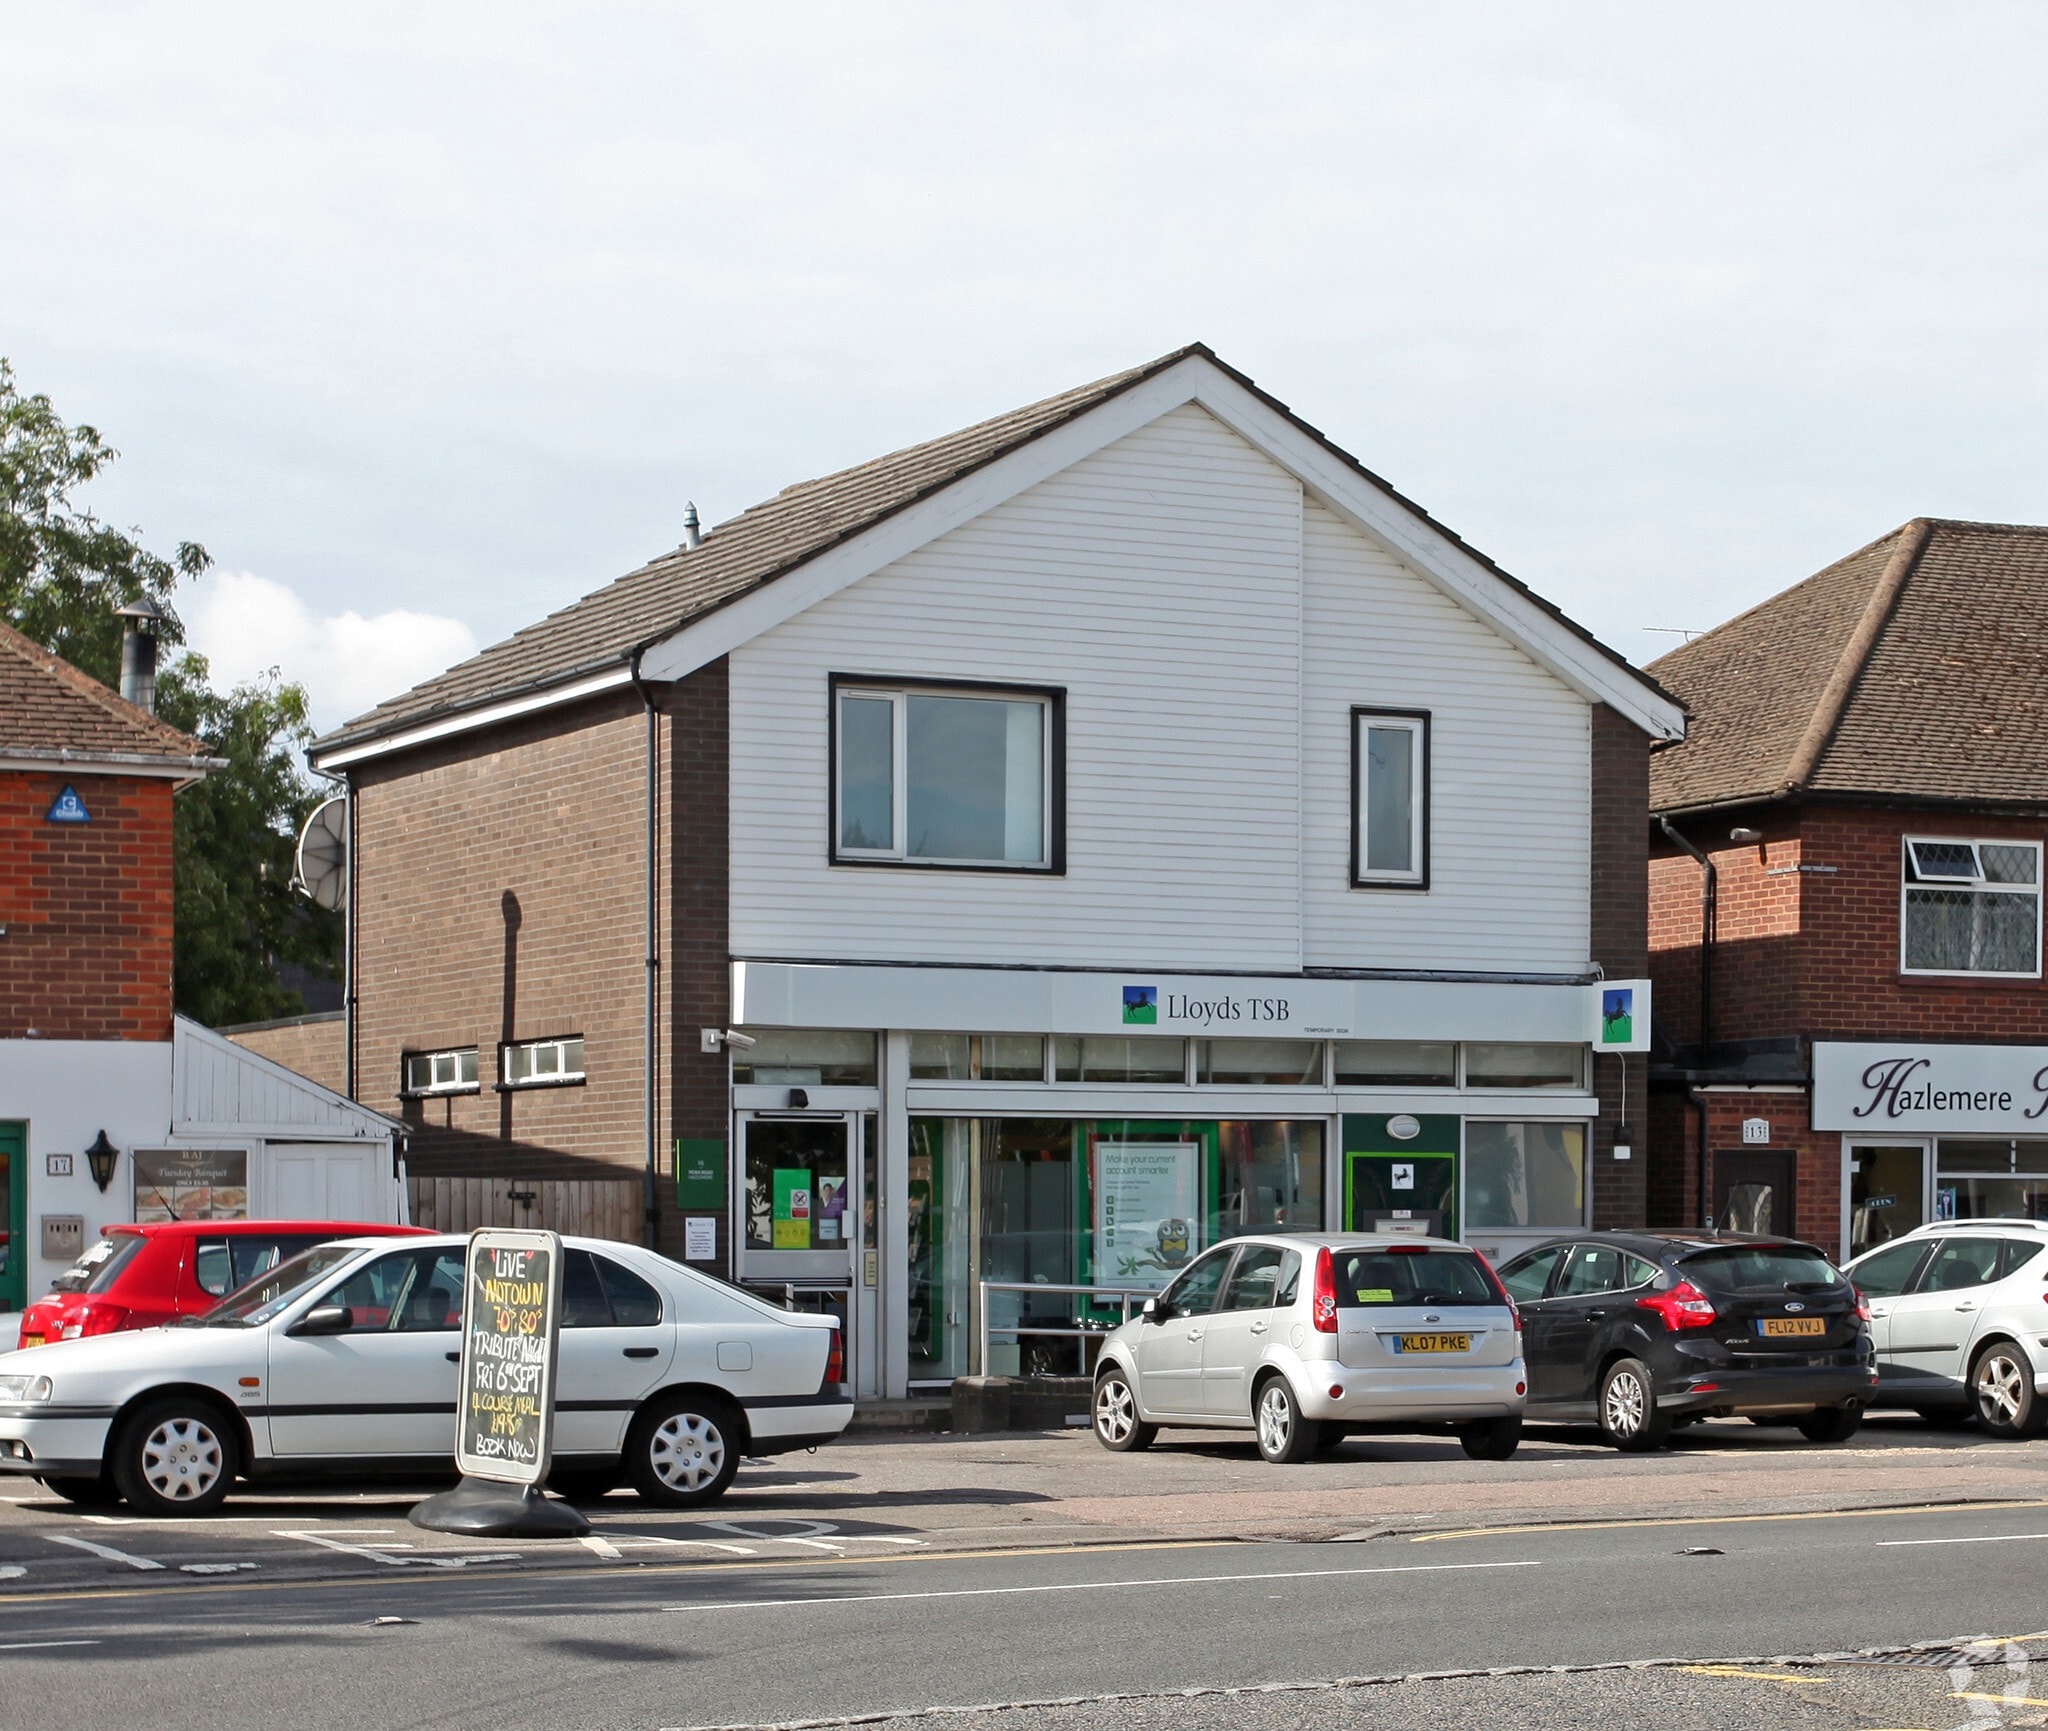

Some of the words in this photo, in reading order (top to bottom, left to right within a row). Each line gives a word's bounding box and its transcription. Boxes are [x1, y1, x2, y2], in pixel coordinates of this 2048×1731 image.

[1168, 995, 1240, 1026] Lloyds
[1248, 998, 1290, 1020] TSB
[1853, 1058, 2012, 1118] Hazlemere
[1750, 1126, 1763, 1138] 13
[182, 1151, 203, 1160] RAJ
[1105, 1154, 1128, 1164] Make
[1130, 1155, 1147, 1167] your
[1149, 1155, 1176, 1164] current
[54, 1159, 67, 1171] 17
[1105, 1166, 1137, 1175] account
[1138, 1166, 1169, 1175] smarter
[158, 1167, 192, 1178] Tuesday
[193, 1167, 228, 1179] Banquet
[1768, 1321, 1795, 1334] FL12
[475, 1331, 520, 1361] TRIBUTE
[1401, 1336, 1438, 1350] KL07
[1440, 1335, 1467, 1349] PKE
[510, 1364, 542, 1394] SEPT
[476, 1433, 507, 1455] BOOK
[508, 1437, 536, 1458] NOW
